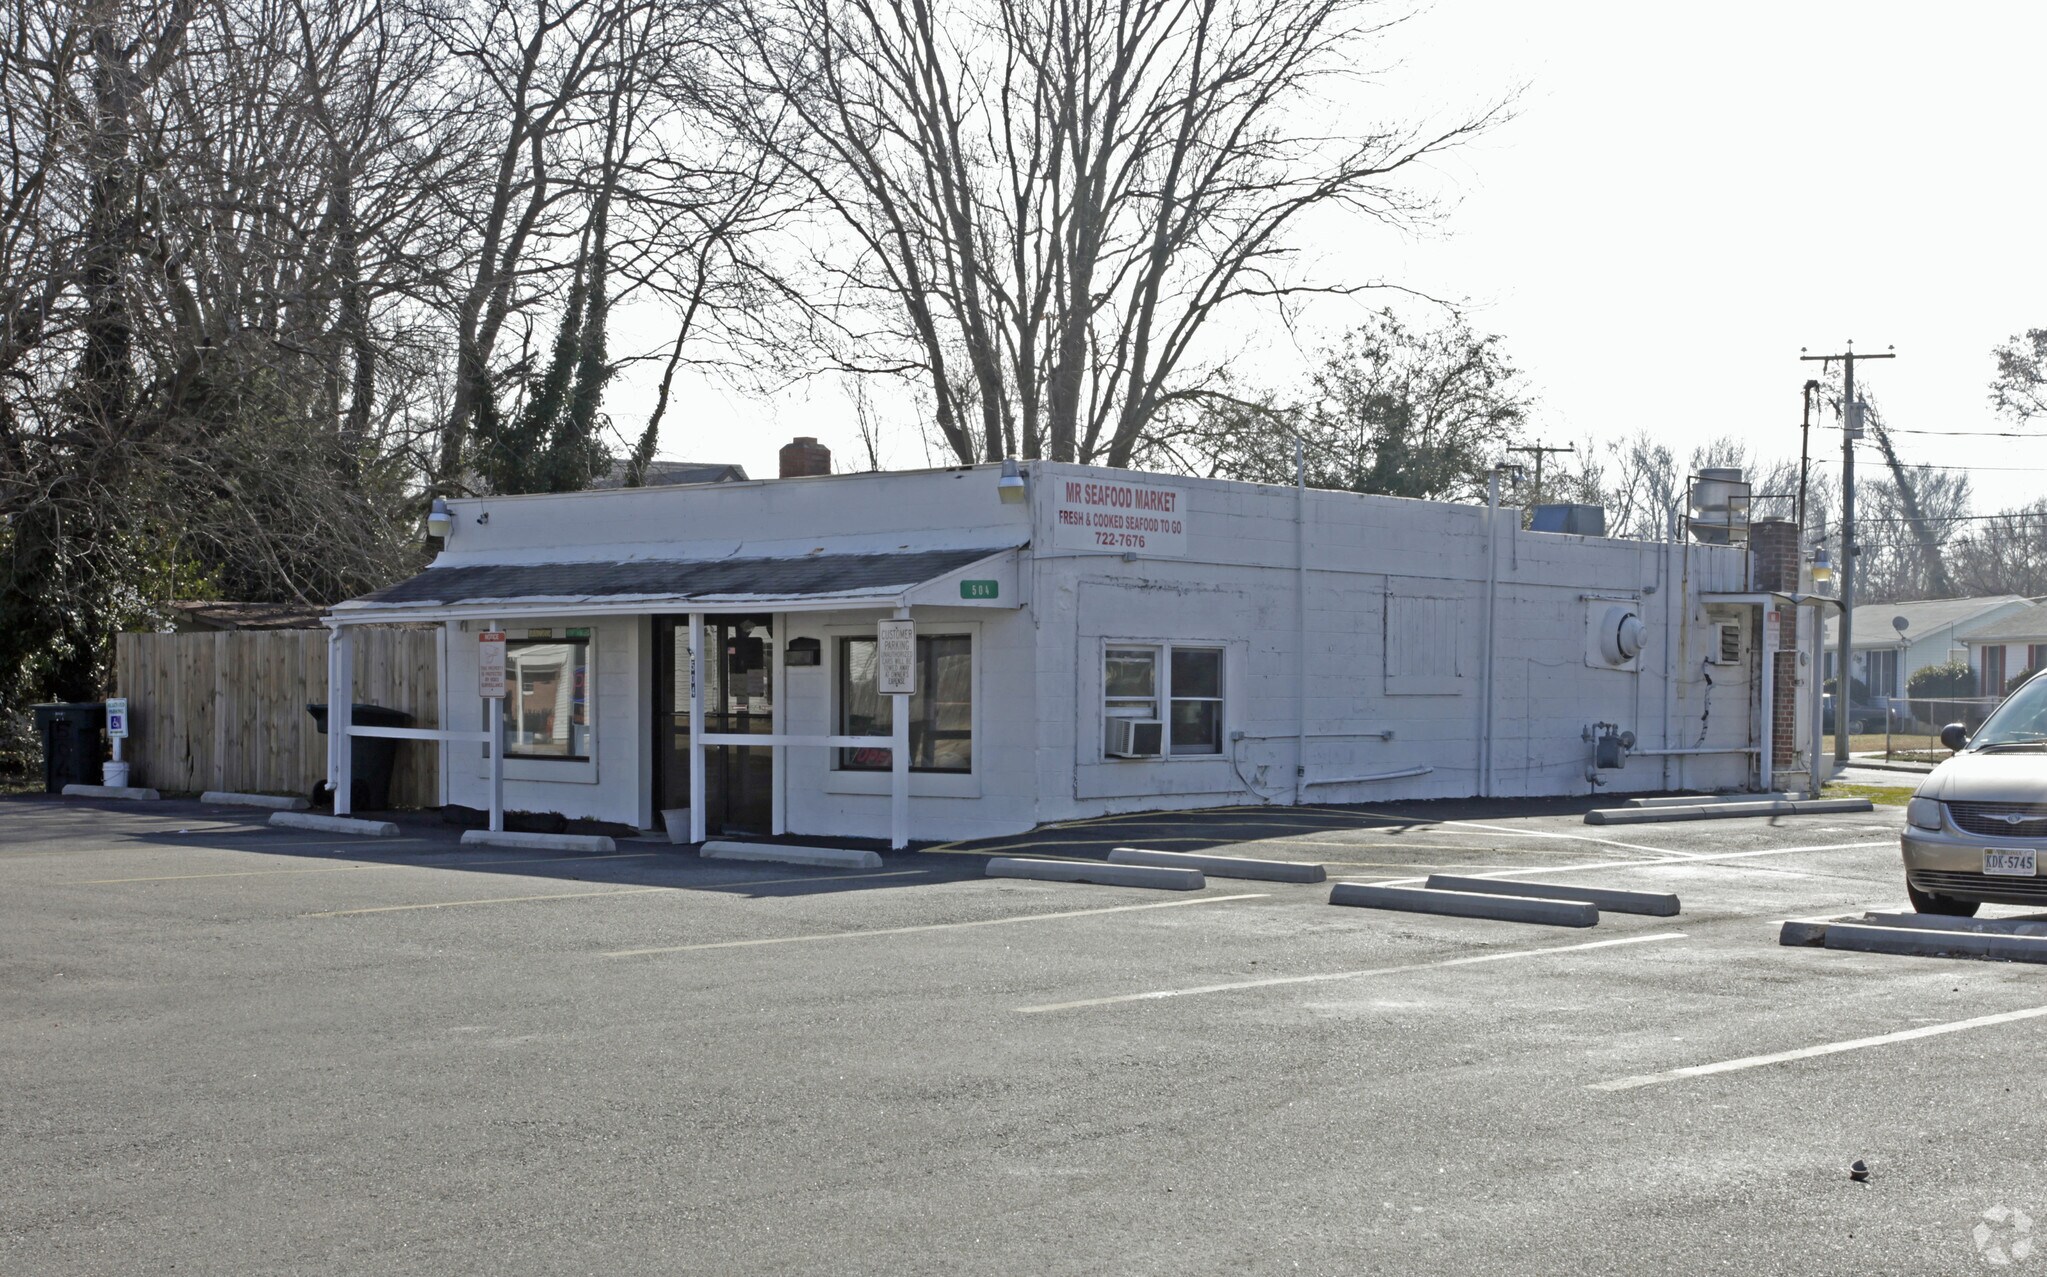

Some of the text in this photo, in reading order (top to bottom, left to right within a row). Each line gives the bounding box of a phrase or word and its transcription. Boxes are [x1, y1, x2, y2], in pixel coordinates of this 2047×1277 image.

[1066, 482, 1176, 512] MR SEAFOOD MARKET
[1059, 510, 1182, 534] FRESH & COOKED SEAFOOD TO GO
[1095, 532, 1145, 548] 722-7676
[972, 585, 989, 595] 504
[881, 629, 912, 639] CUSTOMER
[884, 640, 909, 650] PARKING
[1986, 855, 2033, 869] KDK-5745
